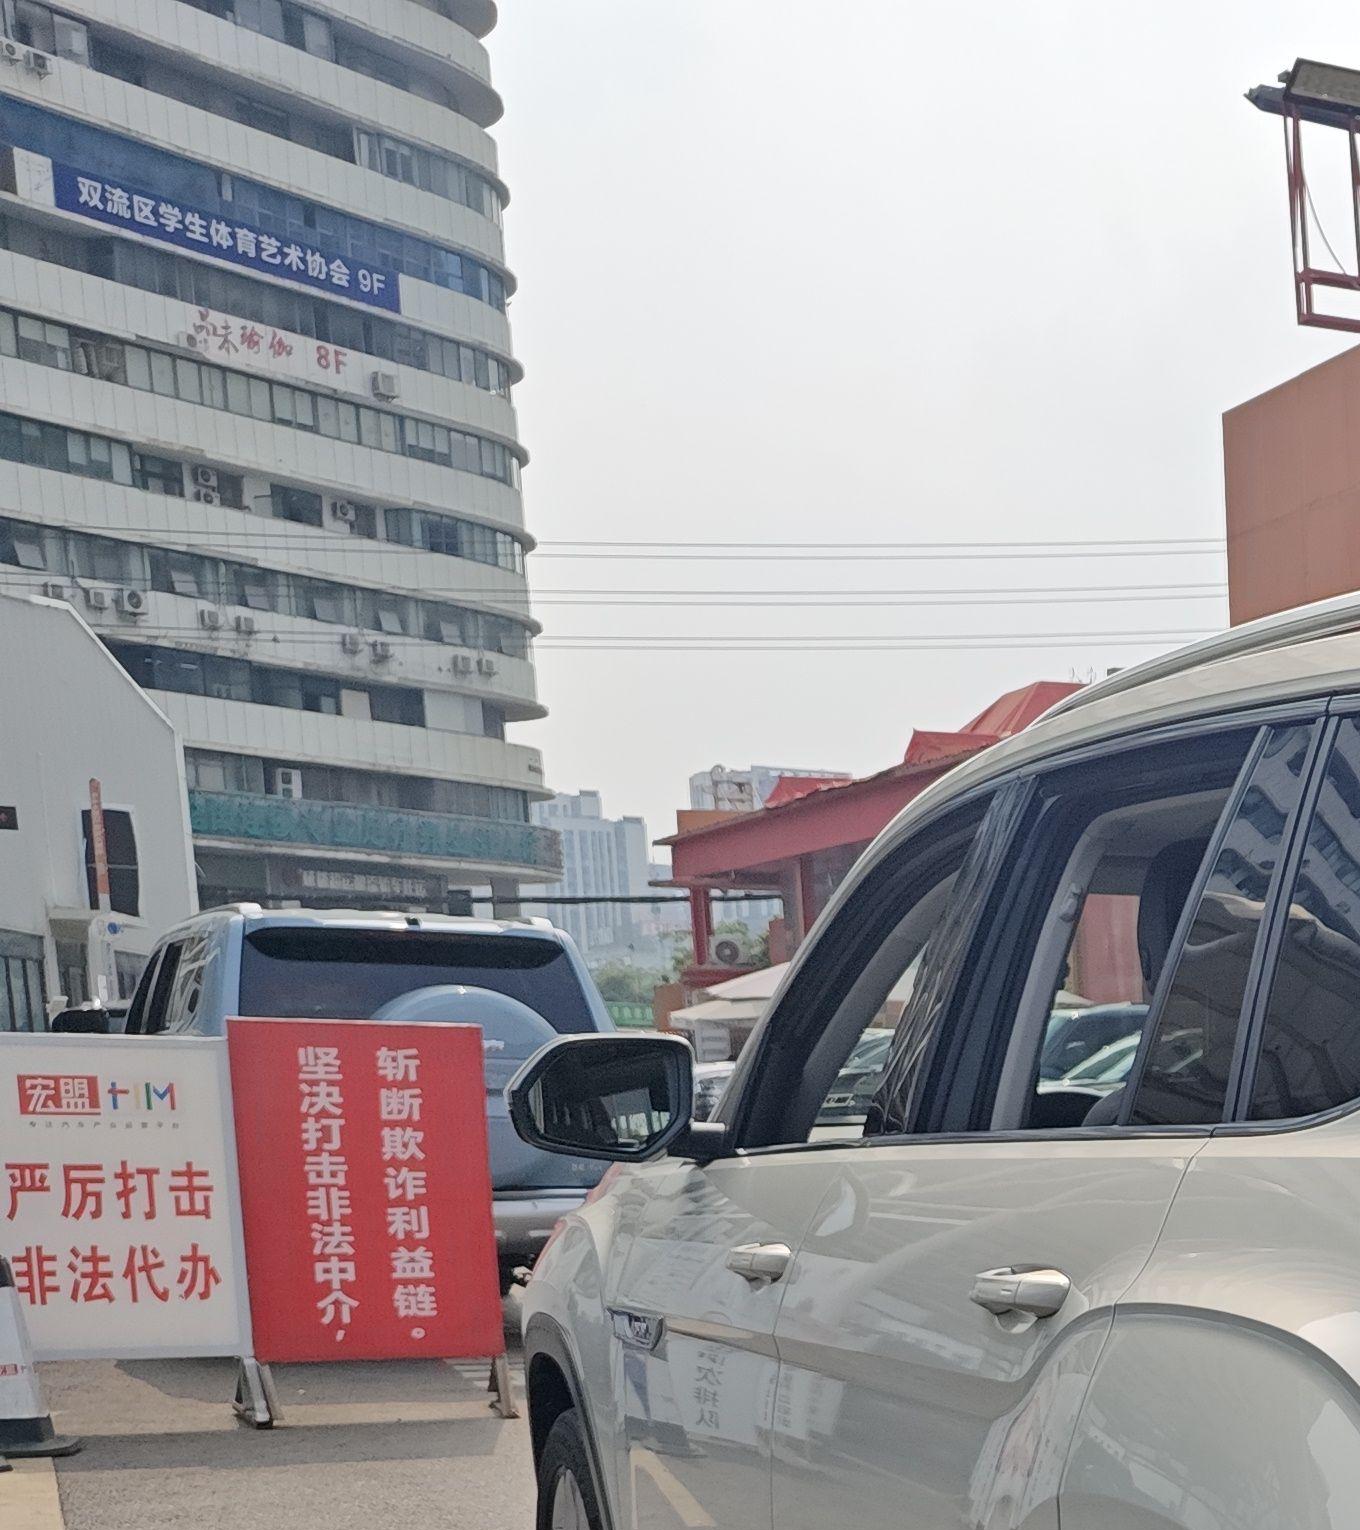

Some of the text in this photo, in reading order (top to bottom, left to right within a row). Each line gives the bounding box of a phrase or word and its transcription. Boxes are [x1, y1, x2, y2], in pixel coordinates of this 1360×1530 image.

[76, 174, 386, 296] 双流区学生体育艺术协会 9F
[316, 344, 348, 375] 8F
[24, 1076, 95, 1114] 宏盟
[5, 1160, 214, 1221] 严厉打击
[12, 1242, 222, 1306] 非法代办
